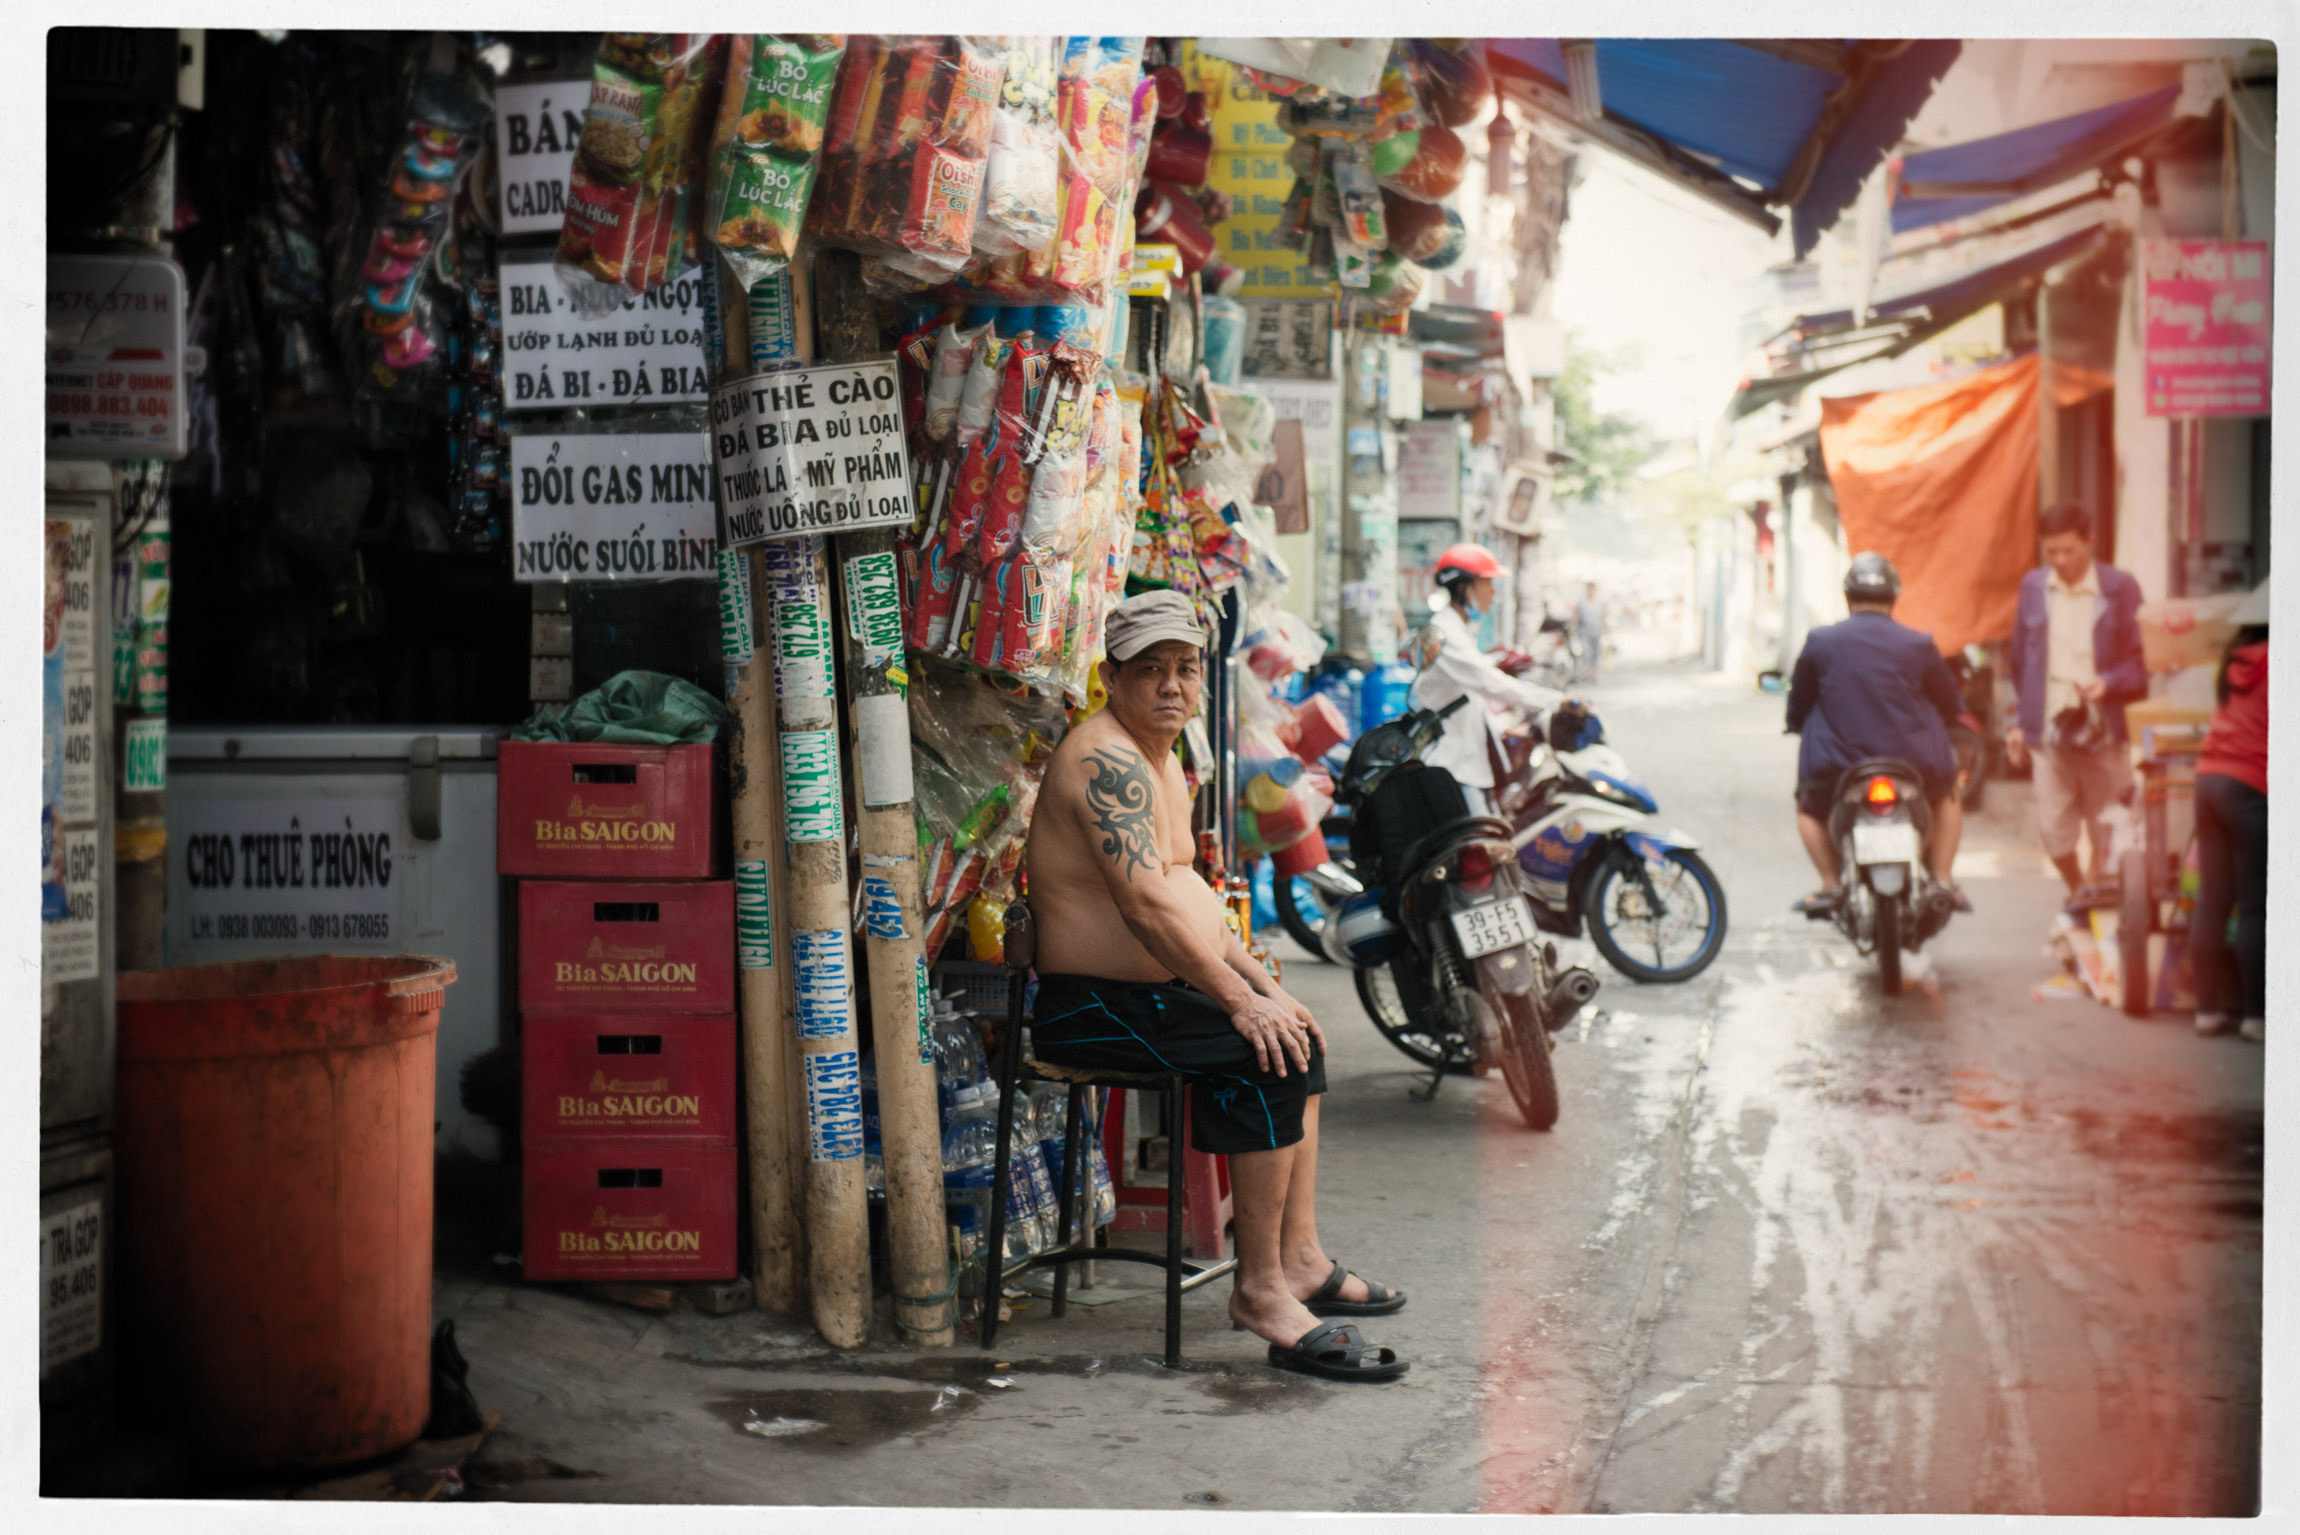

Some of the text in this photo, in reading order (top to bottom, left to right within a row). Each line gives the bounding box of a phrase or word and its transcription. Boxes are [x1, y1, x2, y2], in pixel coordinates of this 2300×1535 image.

[757, 78, 824, 105] LÚC LẮC
[507, 98, 586, 155] BÁN
[762, 168, 790, 189] BÒ
[739, 182, 803, 213] LÚC LẮC
[510, 285, 551, 314] BIA
[643, 279, 704, 315] NGỌT
[508, 331, 551, 351] ƯỚP
[557, 332, 618, 351] LẠNH
[624, 324, 655, 347] ĐỦ
[515, 360, 709, 400] ĐÁ BI ĐÁ BIA
[714, 372, 895, 425] CÓ BÁN THẺ CÀO
[719, 411, 899, 459] ĐÁ BIA ĐỦ LOẠI
[521, 441, 574, 506] ĐỔI
[582, 465, 643, 505] GAS
[724, 439, 902, 503] THUỐC LÁ MỸ PHẨM
[729, 492, 908, 541] NƯỚC UỐNG ĐỦ LOẠI
[519, 531, 589, 574] NƯỚC
[596, 523, 656, 573] SUỐI
[858, 553, 900, 648] 0938.682.258
[66, 735, 91, 765] 406
[783, 733, 834, 842] 0933.796.793
[535, 820, 676, 842] Bia SAIGON
[187, 816, 392, 888] CHO THUÊ PHÒNG
[218, 914, 248, 940] 0938
[253, 914, 298, 940] 003093
[310, 914, 340, 939] 0913
[343, 913, 389, 939] 678055
[1464, 902, 1518, 931] 39-F5
[1471, 920, 1526, 951] 3551
[555, 962, 697, 983] Bia SAIGON
[558, 1095, 699, 1117] Bia SAIGON
[558, 1230, 700, 1252] Bia SAIGON
